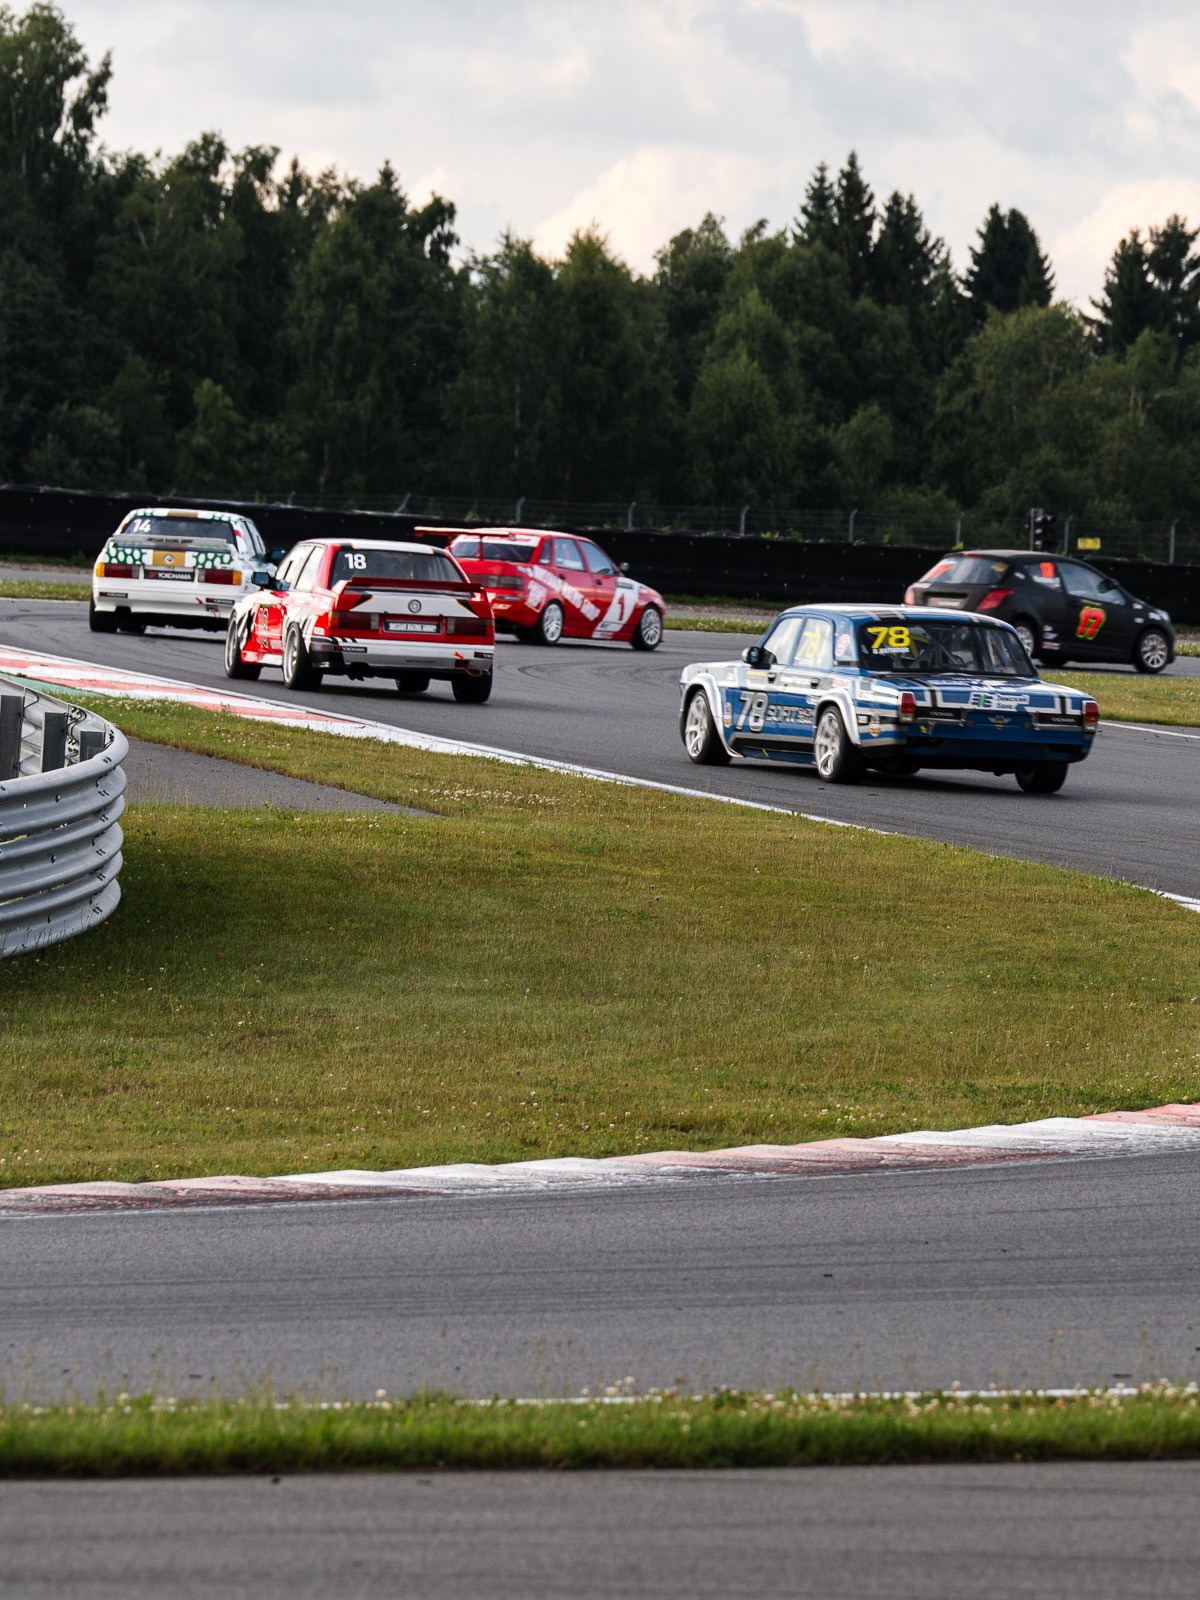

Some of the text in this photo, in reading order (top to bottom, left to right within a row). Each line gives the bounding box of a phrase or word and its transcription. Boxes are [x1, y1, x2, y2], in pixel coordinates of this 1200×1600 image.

[133, 519, 151, 532] 14
[344, 553, 367, 570] 18
[158, 572, 192, 580] YOKOHAMA
[867, 626, 911, 649] 78
[735, 690, 768, 732] 78
